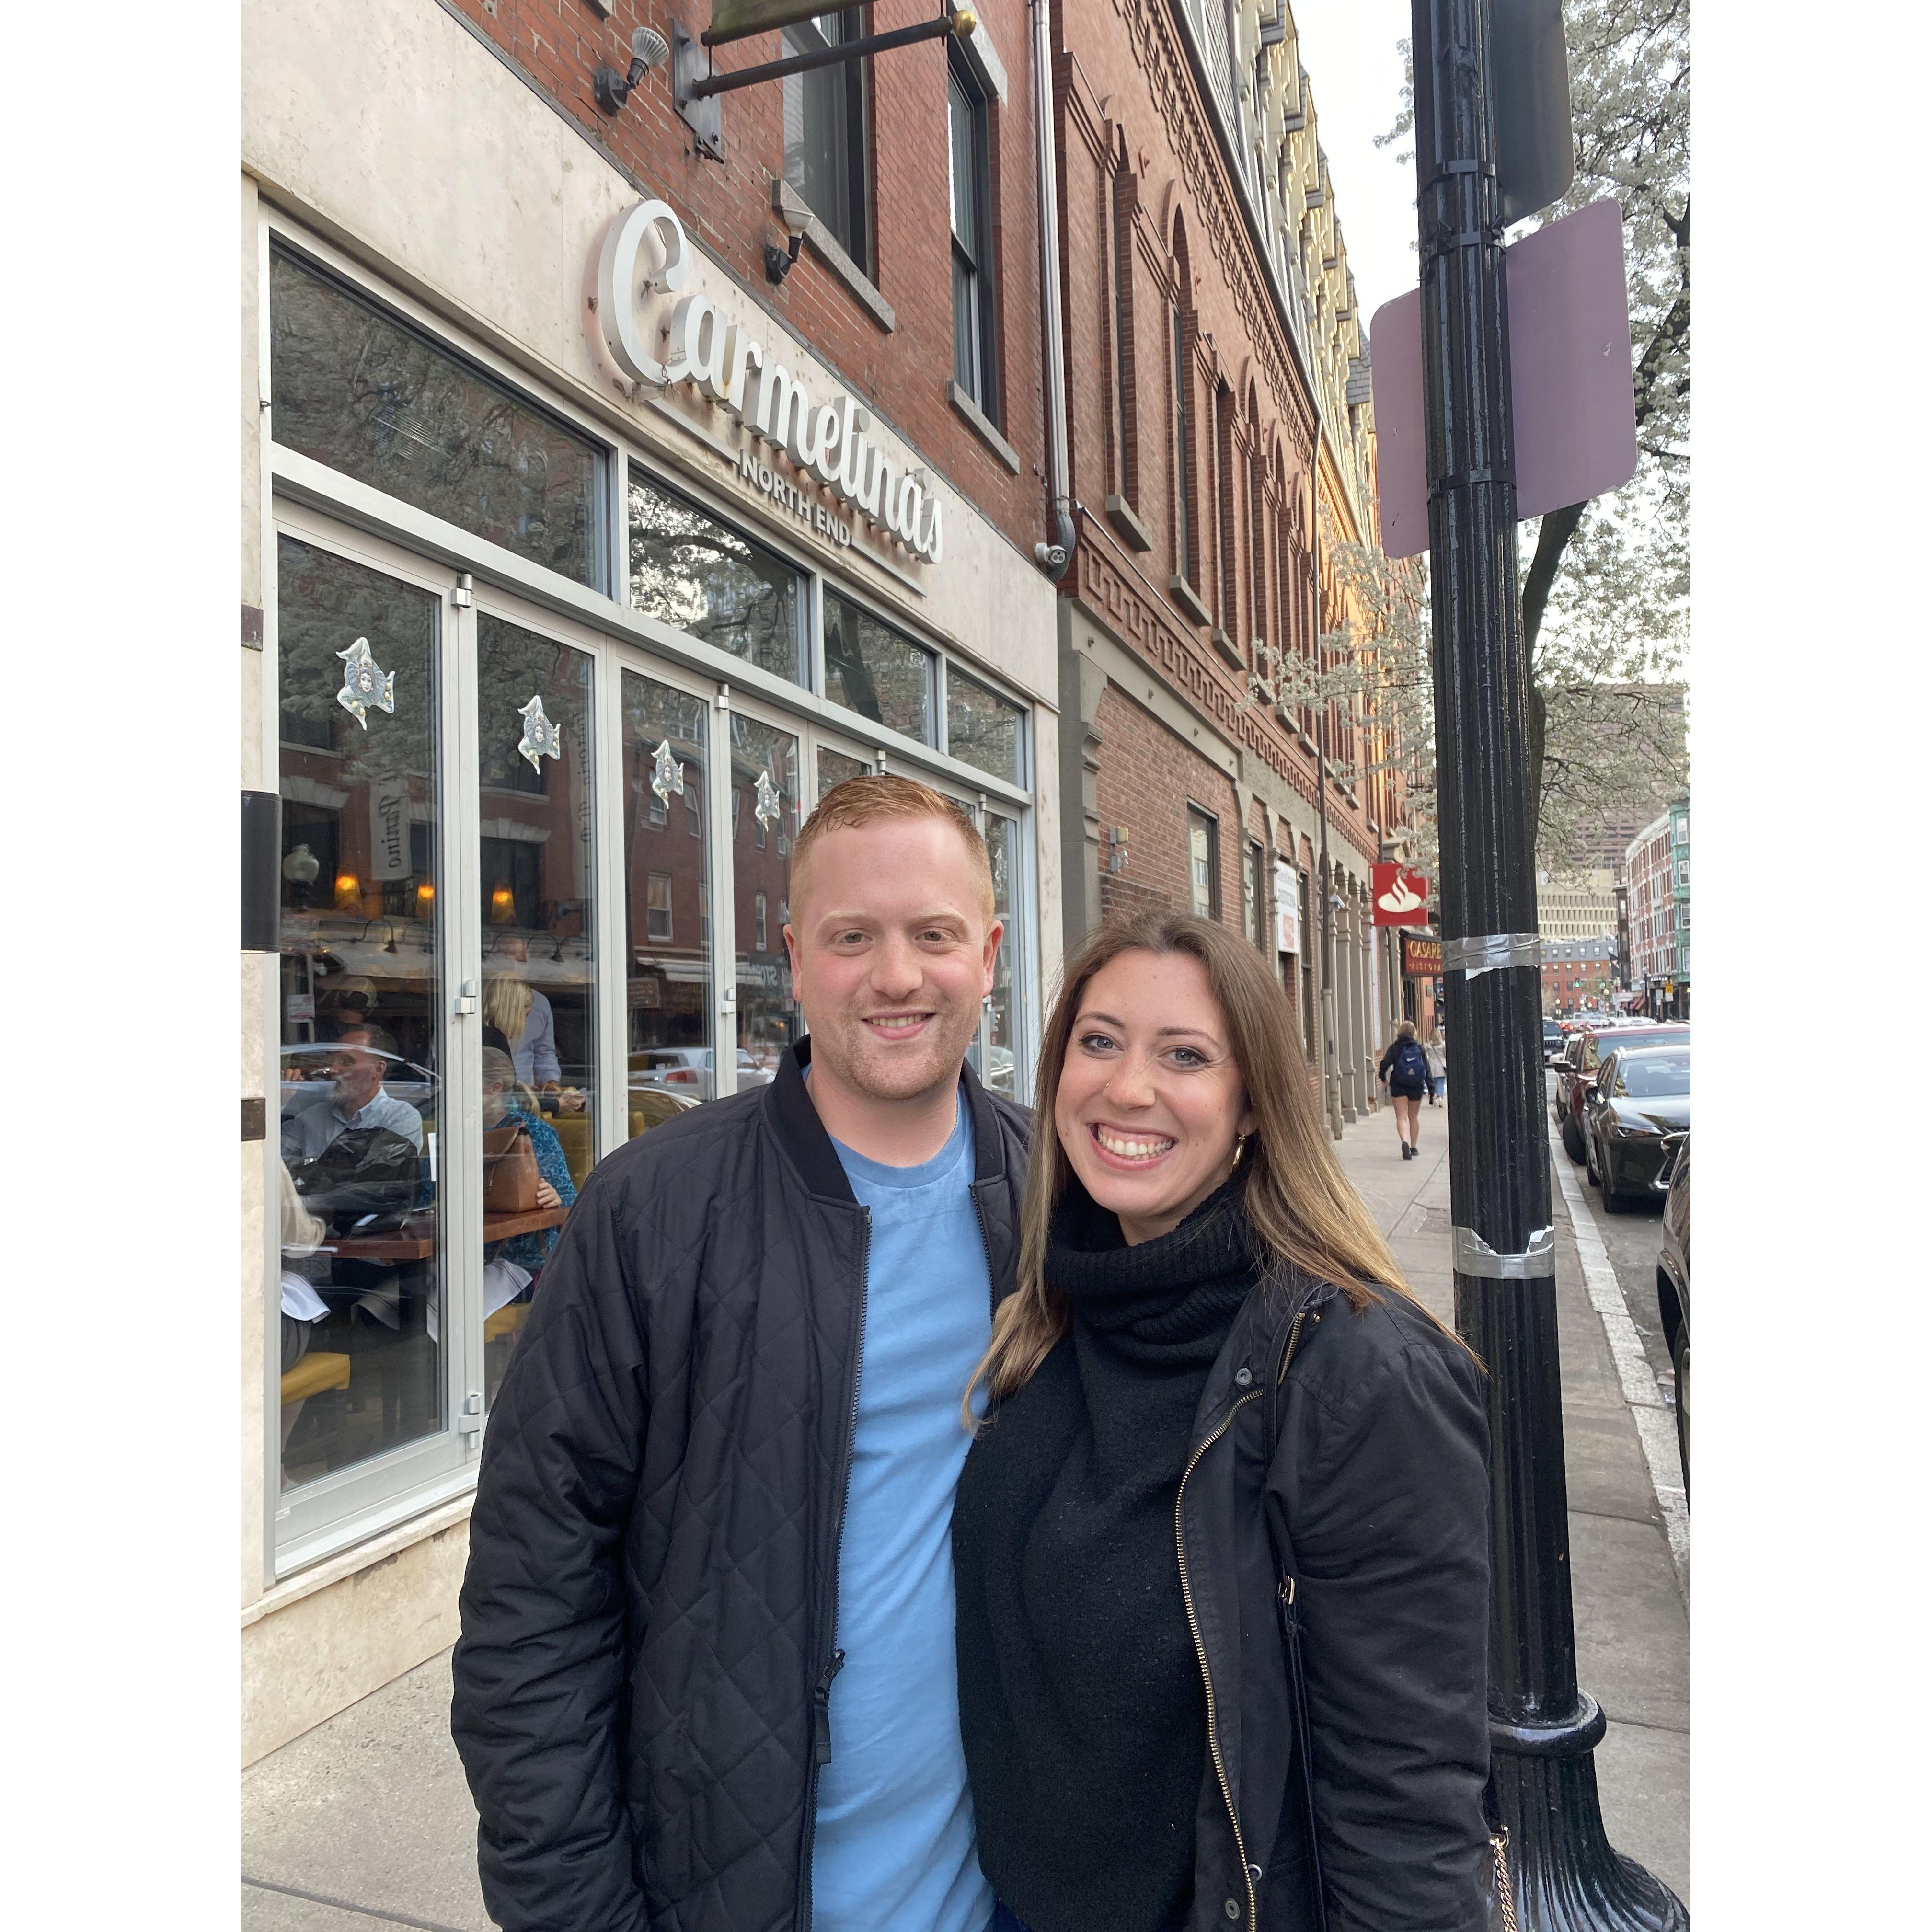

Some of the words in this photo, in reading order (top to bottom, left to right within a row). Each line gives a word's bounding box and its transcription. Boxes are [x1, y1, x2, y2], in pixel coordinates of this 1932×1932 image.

[598, 199, 943, 565] Carmelina's
[742, 451, 811, 522] NORTH
[814, 503, 851, 546] END
